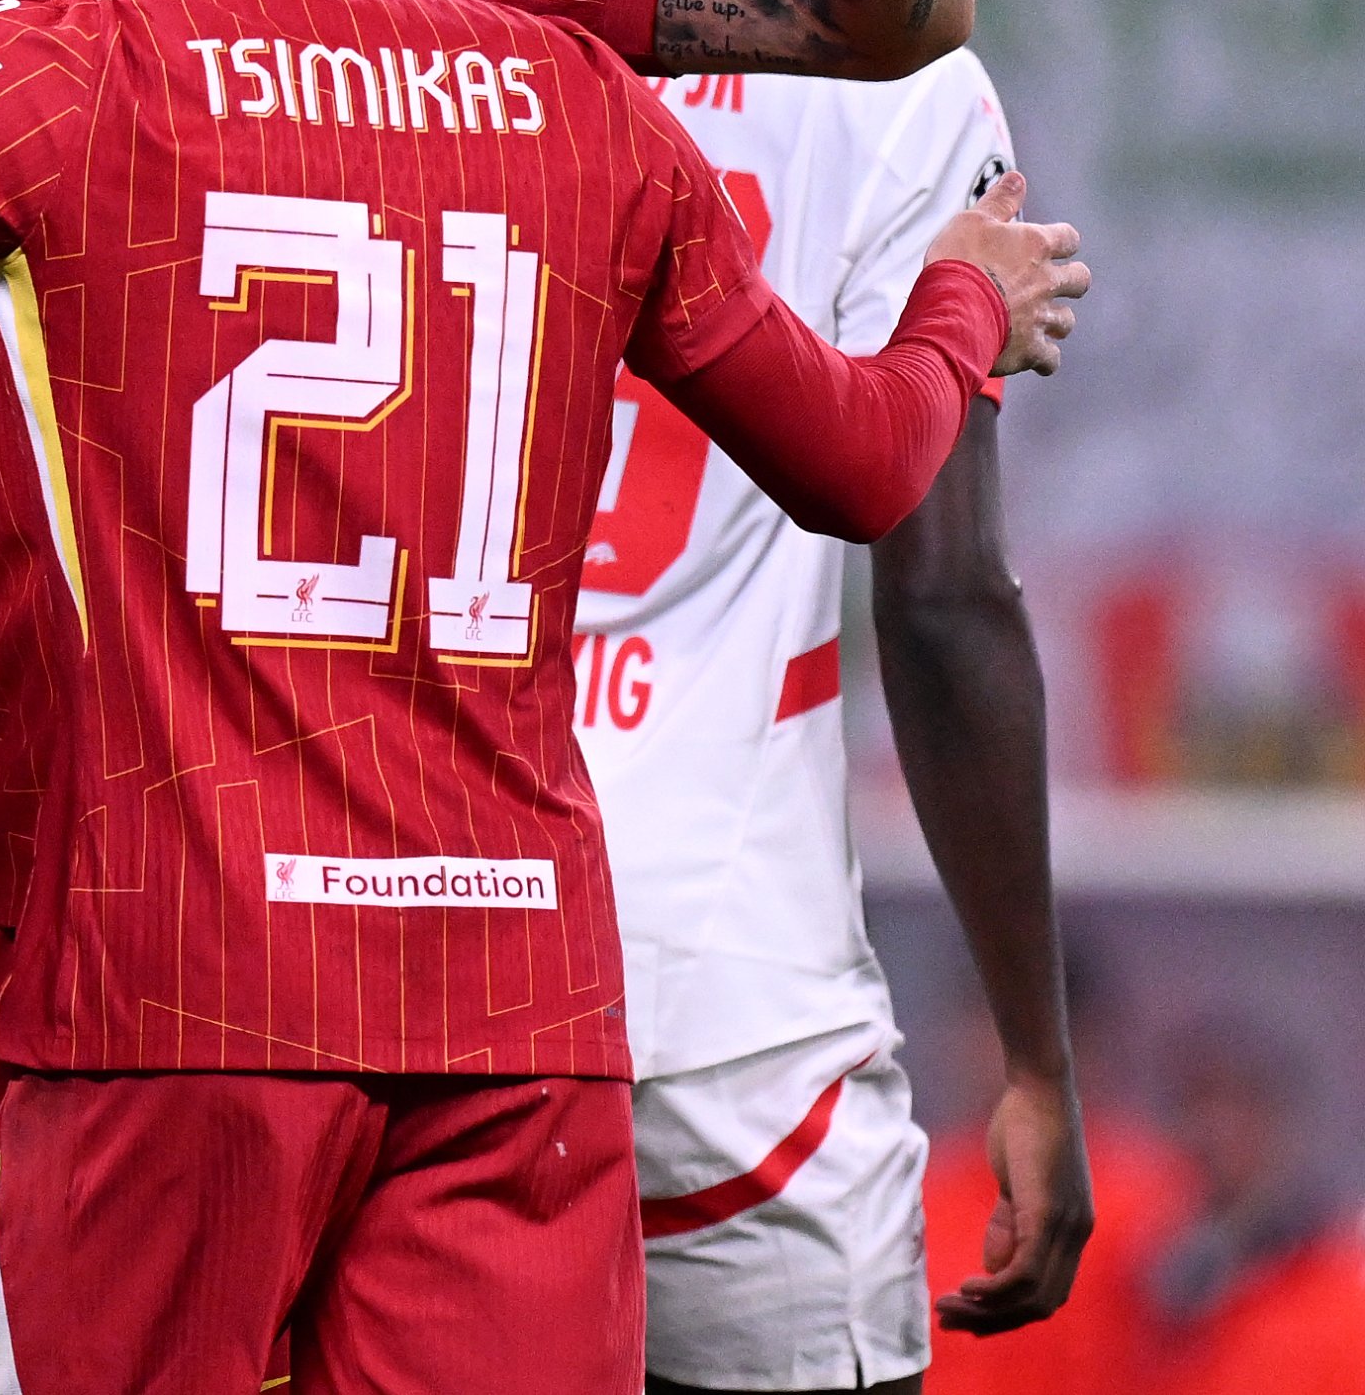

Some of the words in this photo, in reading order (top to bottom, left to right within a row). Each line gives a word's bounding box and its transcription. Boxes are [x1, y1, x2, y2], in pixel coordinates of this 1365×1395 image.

[712, 0, 746, 23] up,
[185, 37, 547, 136] TSIMIKAS
[185, 190, 551, 669] 21
[321, 865, 545, 900] Foundation
